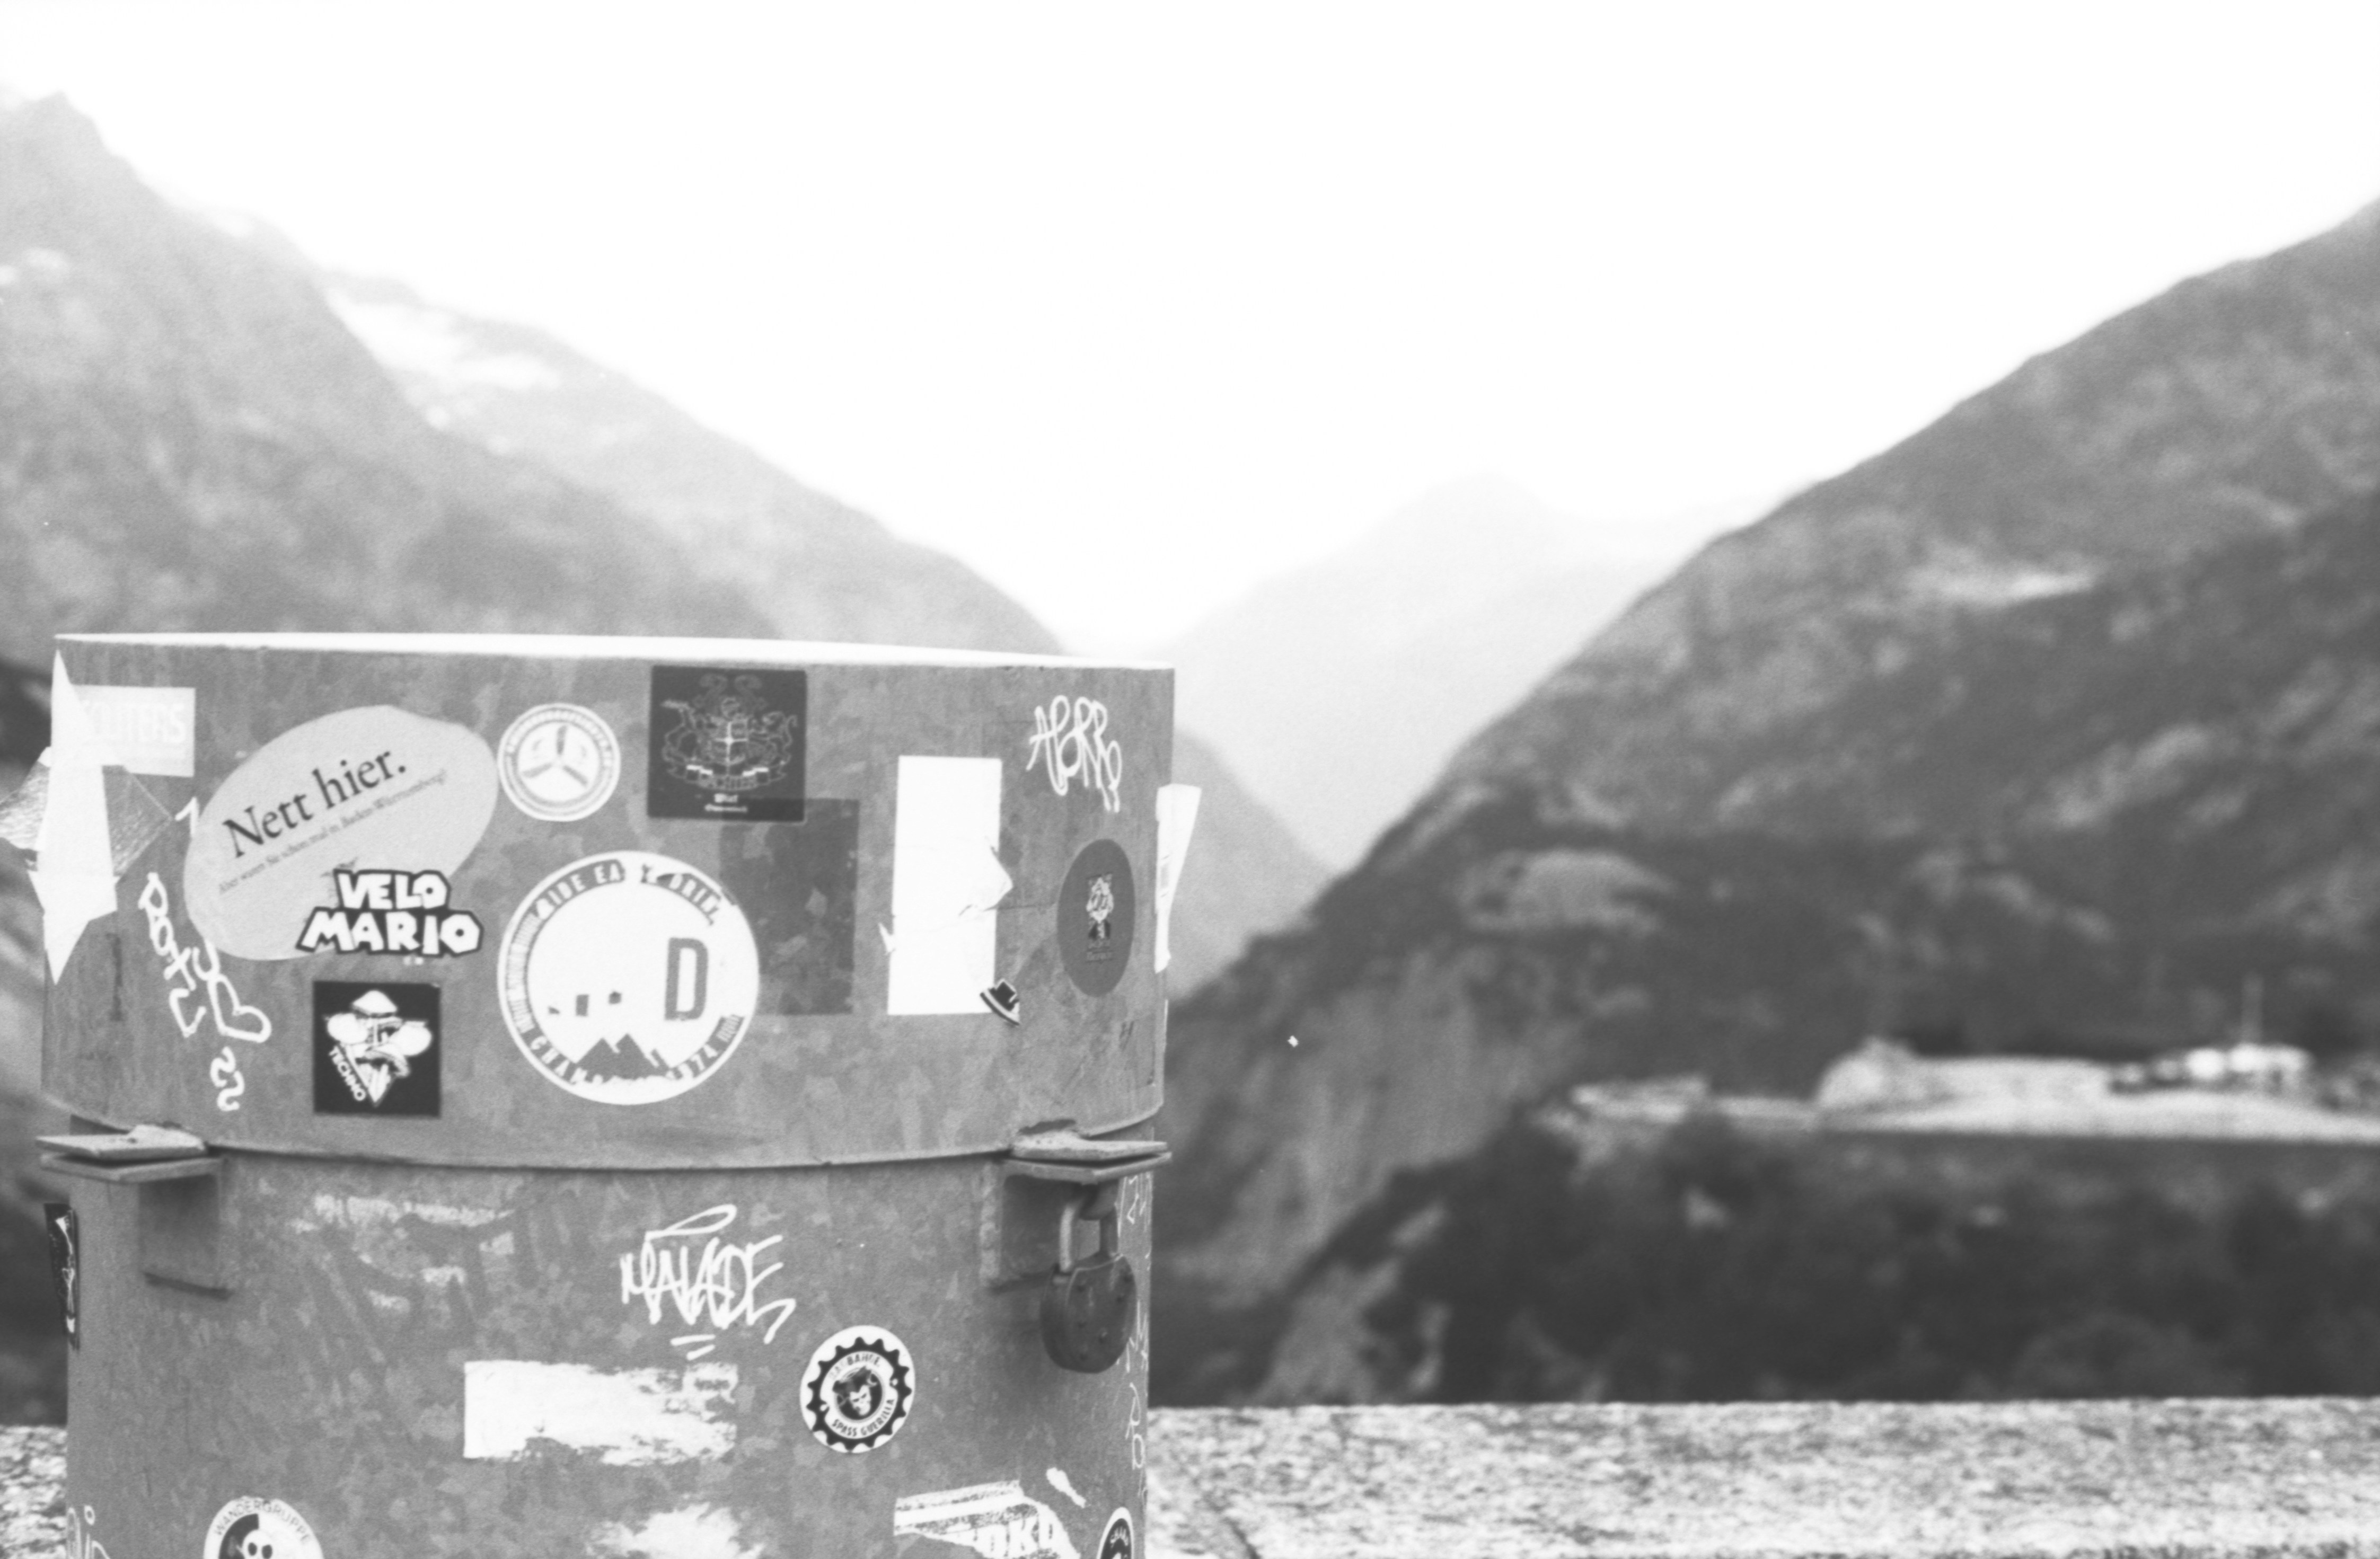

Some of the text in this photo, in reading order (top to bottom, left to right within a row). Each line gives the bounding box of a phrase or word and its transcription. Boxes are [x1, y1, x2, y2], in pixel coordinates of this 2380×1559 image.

[223, 749, 406, 858] Nett hier.
[335, 871, 449, 909] VELO
[299, 909, 481, 956] MARIO
[329, 1046, 365, 1101] TECHNO
[832, 1398, 895, 1437] SPASS GUERILLA
